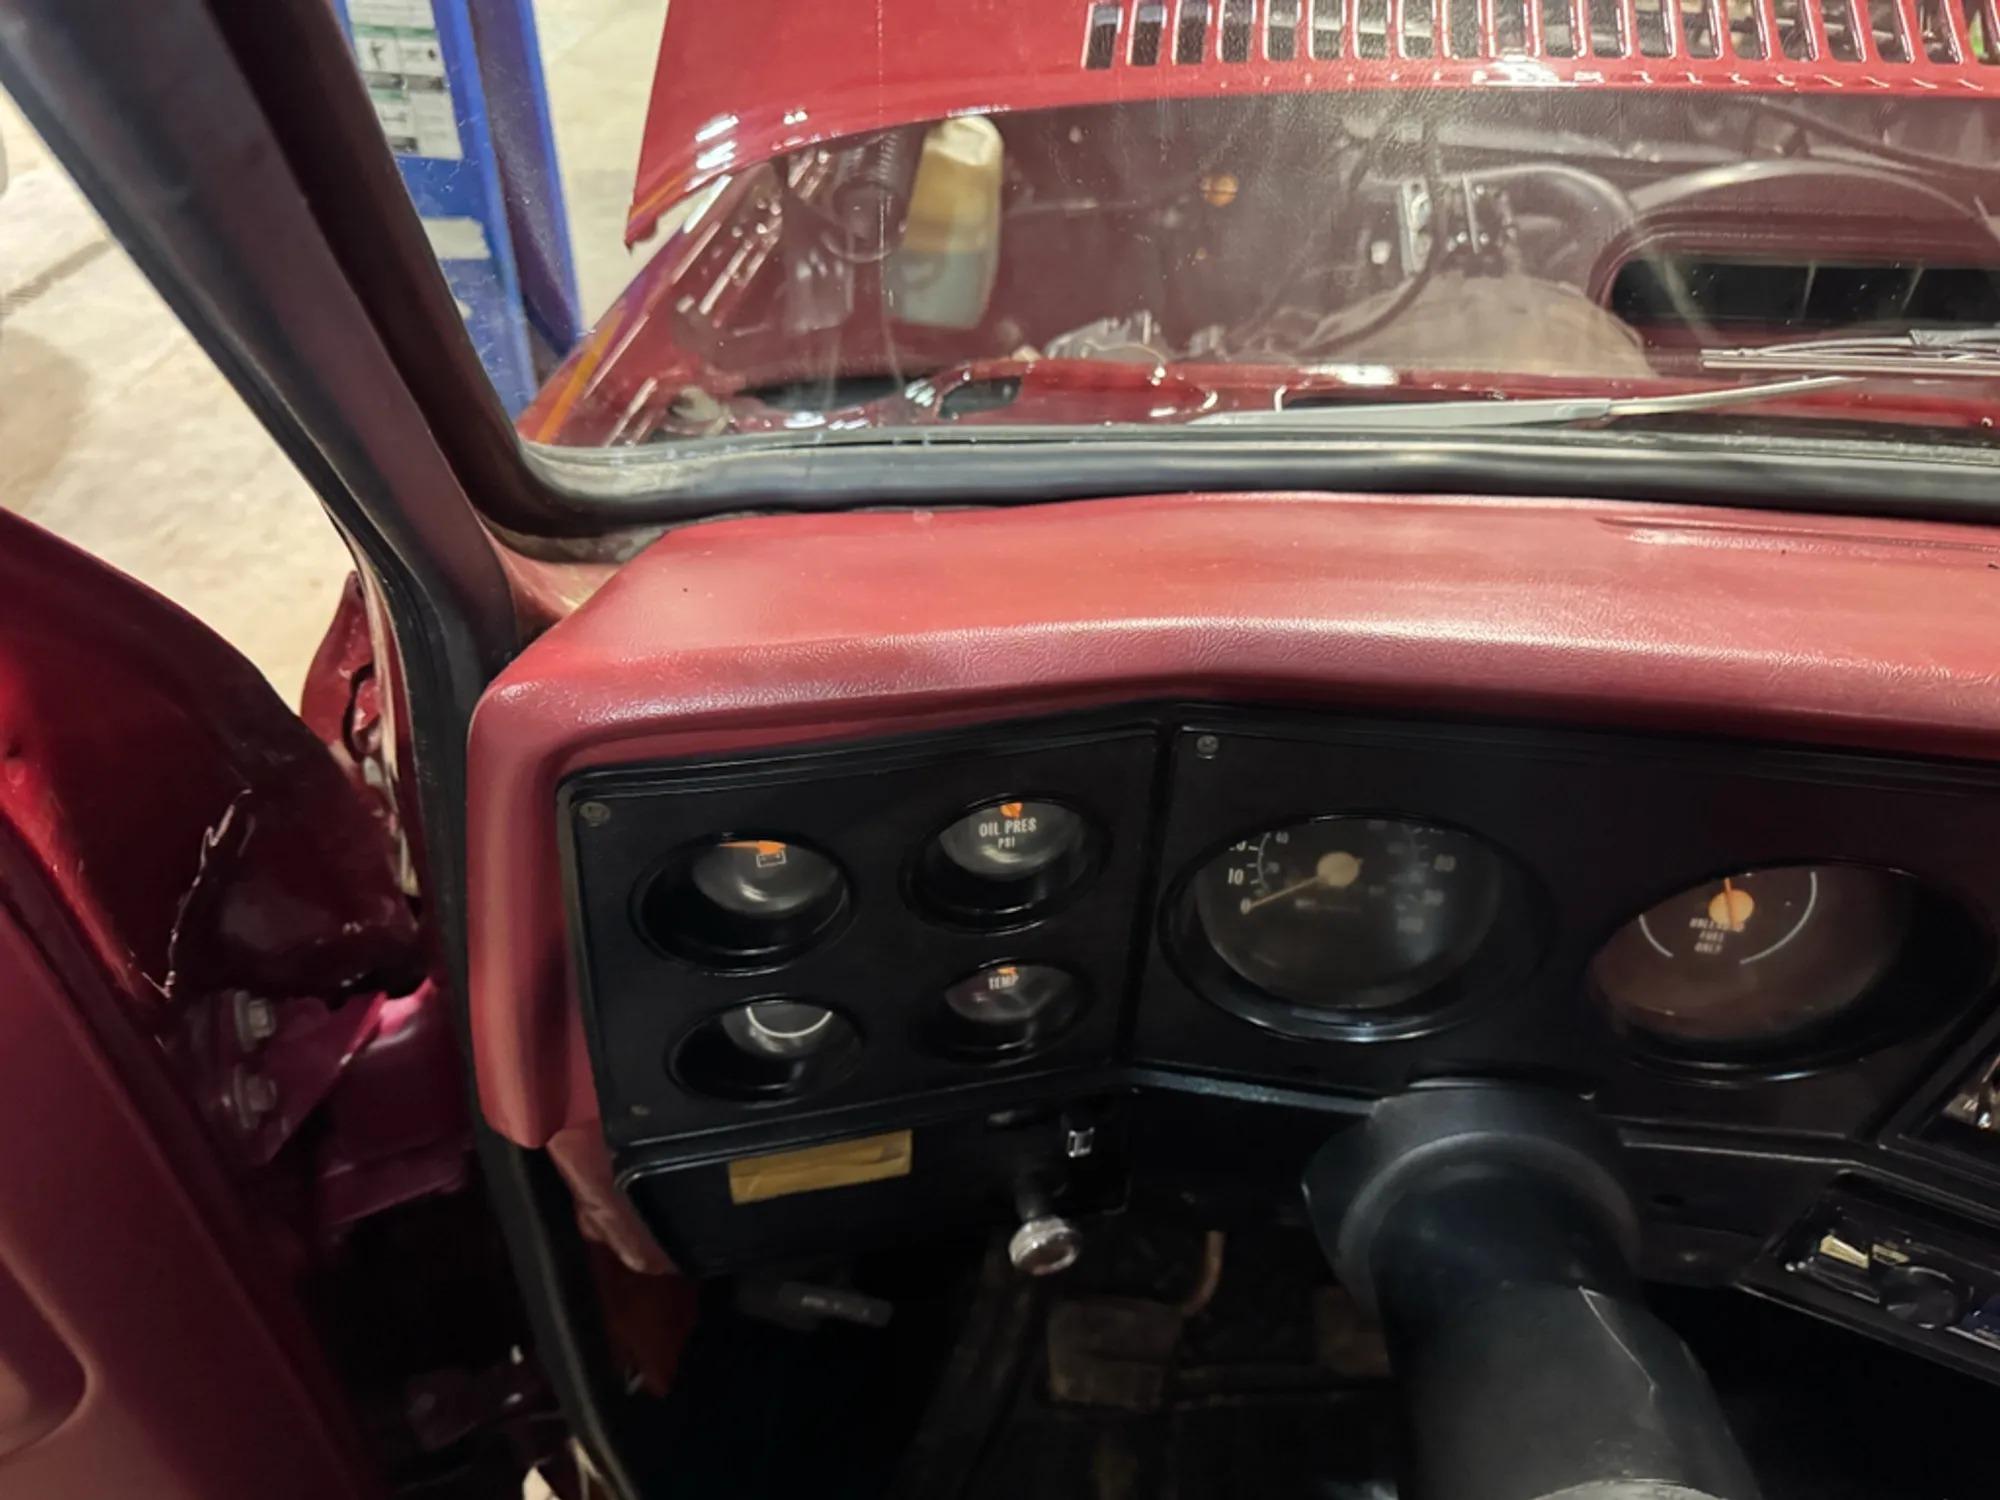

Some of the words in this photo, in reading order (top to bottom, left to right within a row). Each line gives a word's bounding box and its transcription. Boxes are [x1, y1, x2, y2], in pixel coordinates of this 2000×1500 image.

[978, 822, 1000, 838] OIL
[1004, 817, 1037, 834] PRES
[998, 836, 1016, 848] PSI
[1228, 867, 1244, 886] 10
[988, 975, 1019, 990] TEMP
